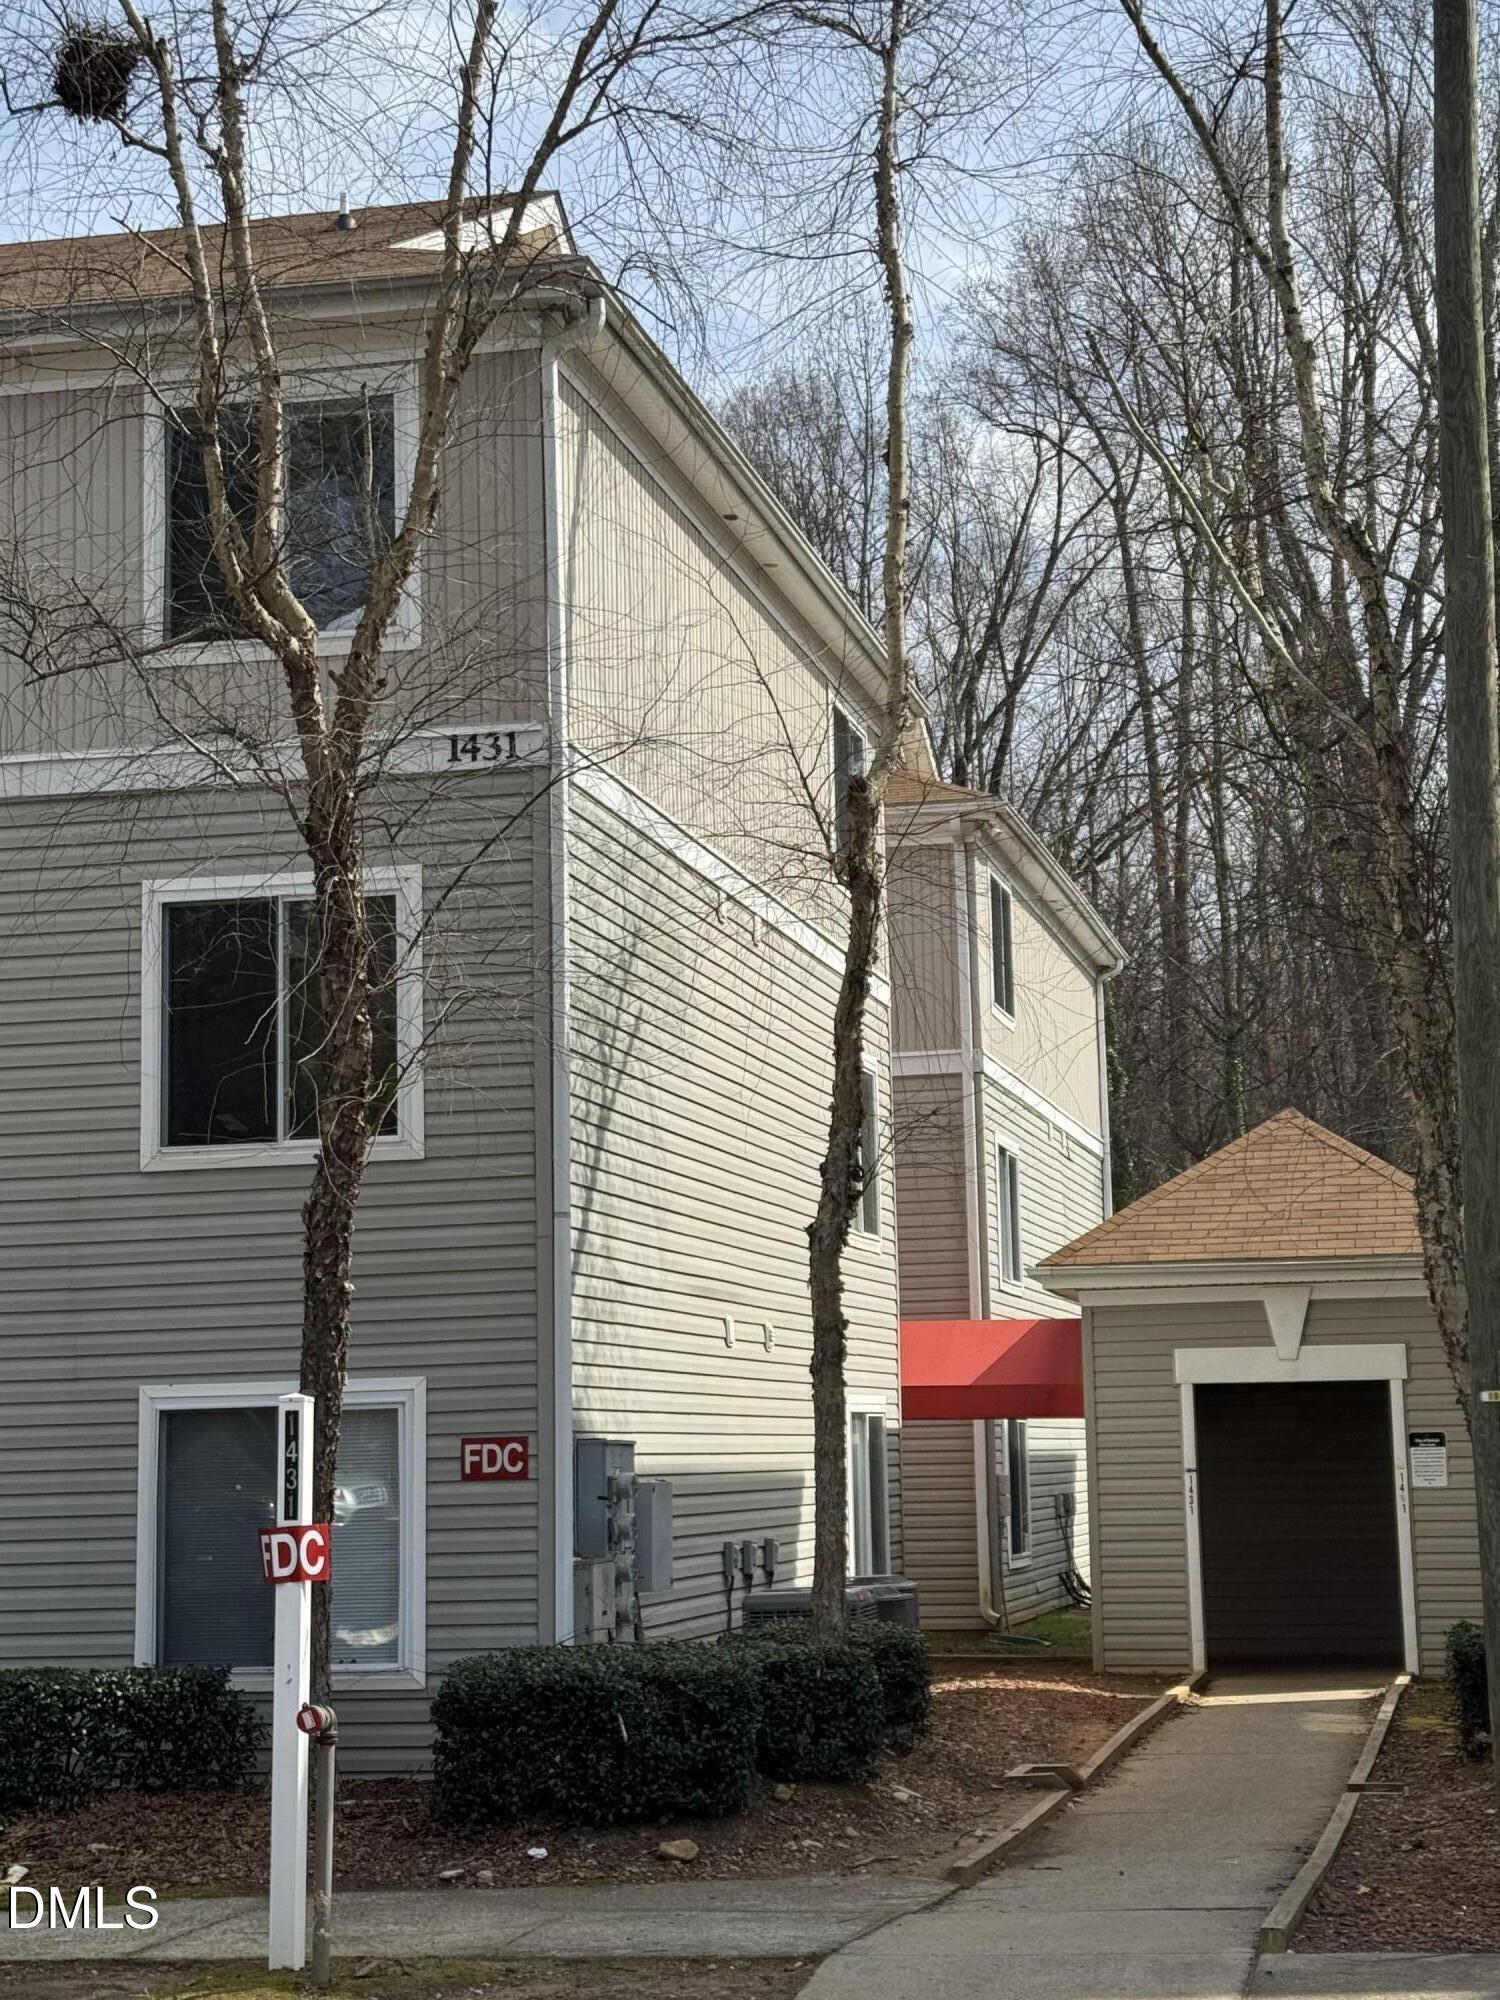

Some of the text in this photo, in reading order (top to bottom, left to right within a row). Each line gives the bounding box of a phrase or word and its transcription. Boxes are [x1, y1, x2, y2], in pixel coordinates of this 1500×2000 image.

[447, 731, 518, 762] 1431
[286, 1413, 298, 1517] 1431
[465, 1442, 524, 1474] FDC
[261, 1530, 325, 1578] FDC
